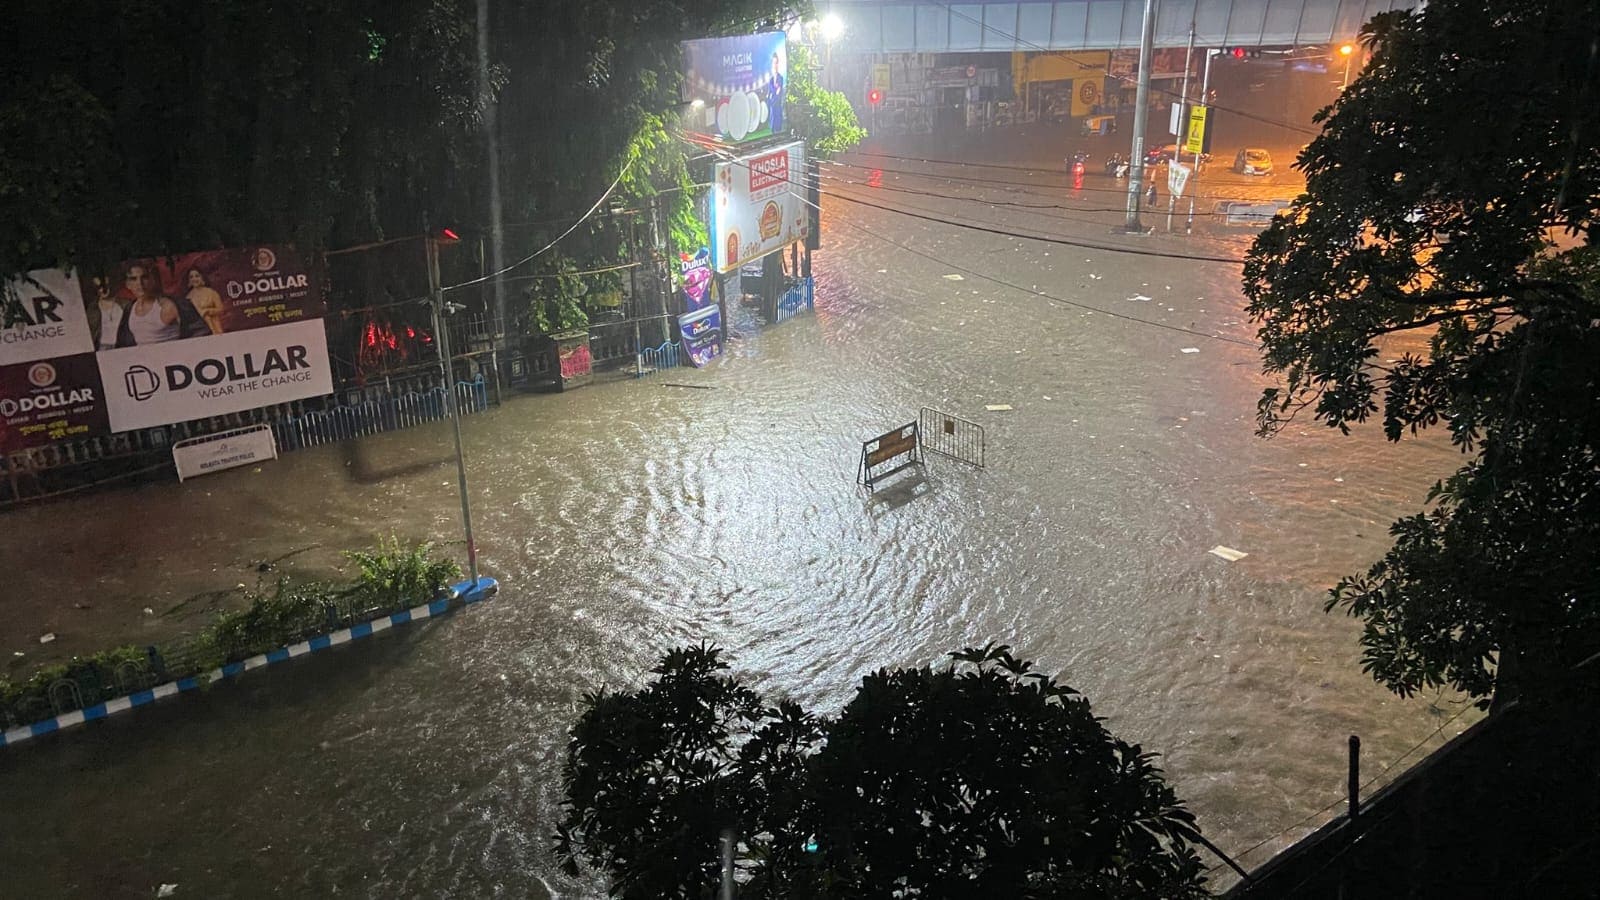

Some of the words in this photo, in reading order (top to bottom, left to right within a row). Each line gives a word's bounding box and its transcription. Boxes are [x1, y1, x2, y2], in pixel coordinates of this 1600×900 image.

[723, 52, 752, 66] MAGIK
[751, 156, 786, 178] KHOSLA
[681, 256, 707, 272] Dulux
[244, 274, 308, 294] DOLLAR
[4, 326, 65, 343] CHANGE
[164, 344, 311, 392] DOLLAR
[198, 385, 235, 400] WEAR
[237, 381, 258, 392] THE
[262, 372, 312, 388] CHANGE
[19, 388, 95, 412] DOLLAR
